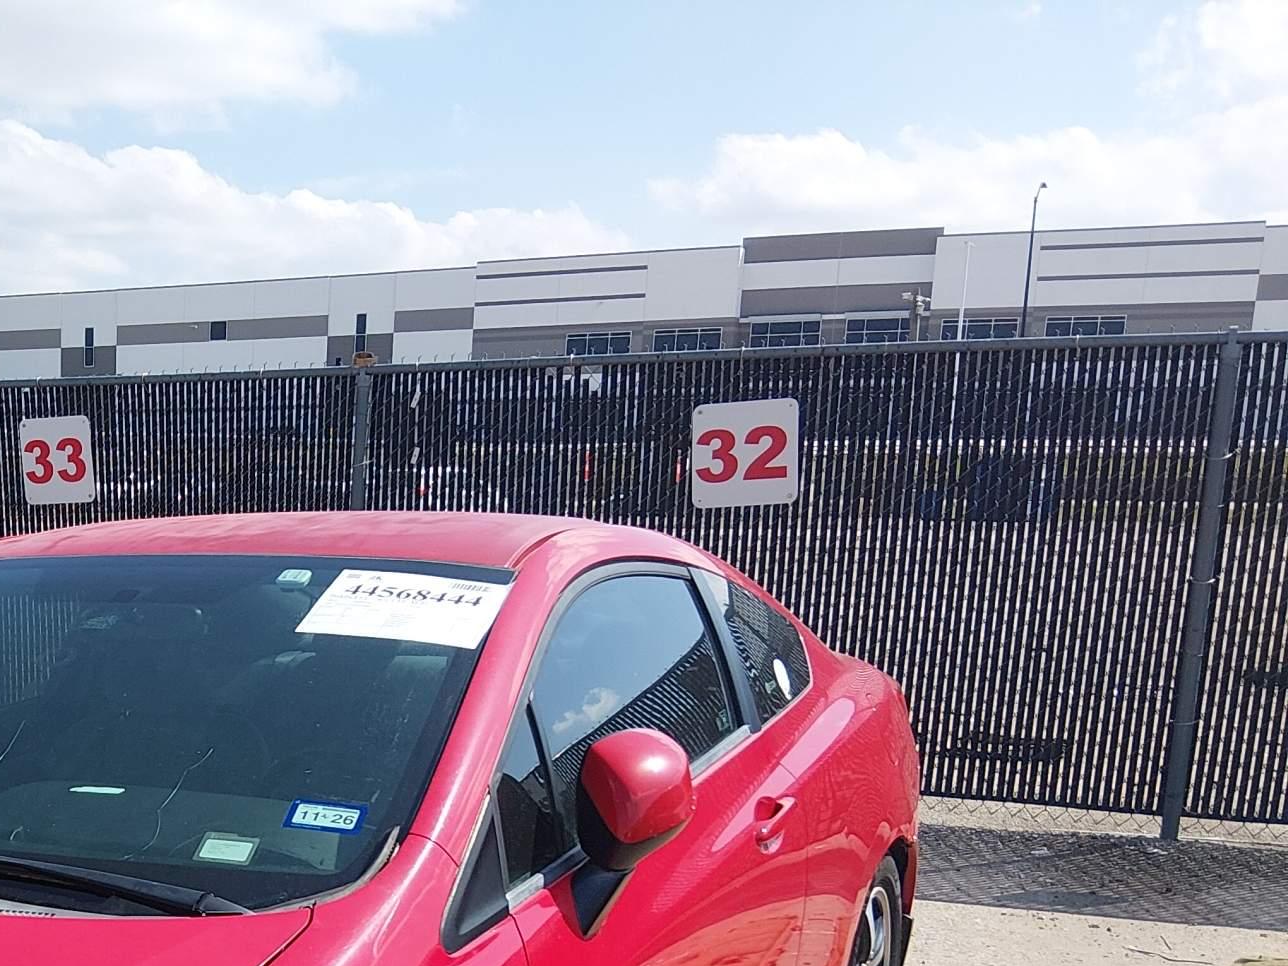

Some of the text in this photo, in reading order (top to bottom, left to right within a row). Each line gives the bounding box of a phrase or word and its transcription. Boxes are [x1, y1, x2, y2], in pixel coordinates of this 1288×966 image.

[23, 437, 87, 484] 33
[695, 425, 788, 483] 32
[344, 583, 483, 607] 44568444
